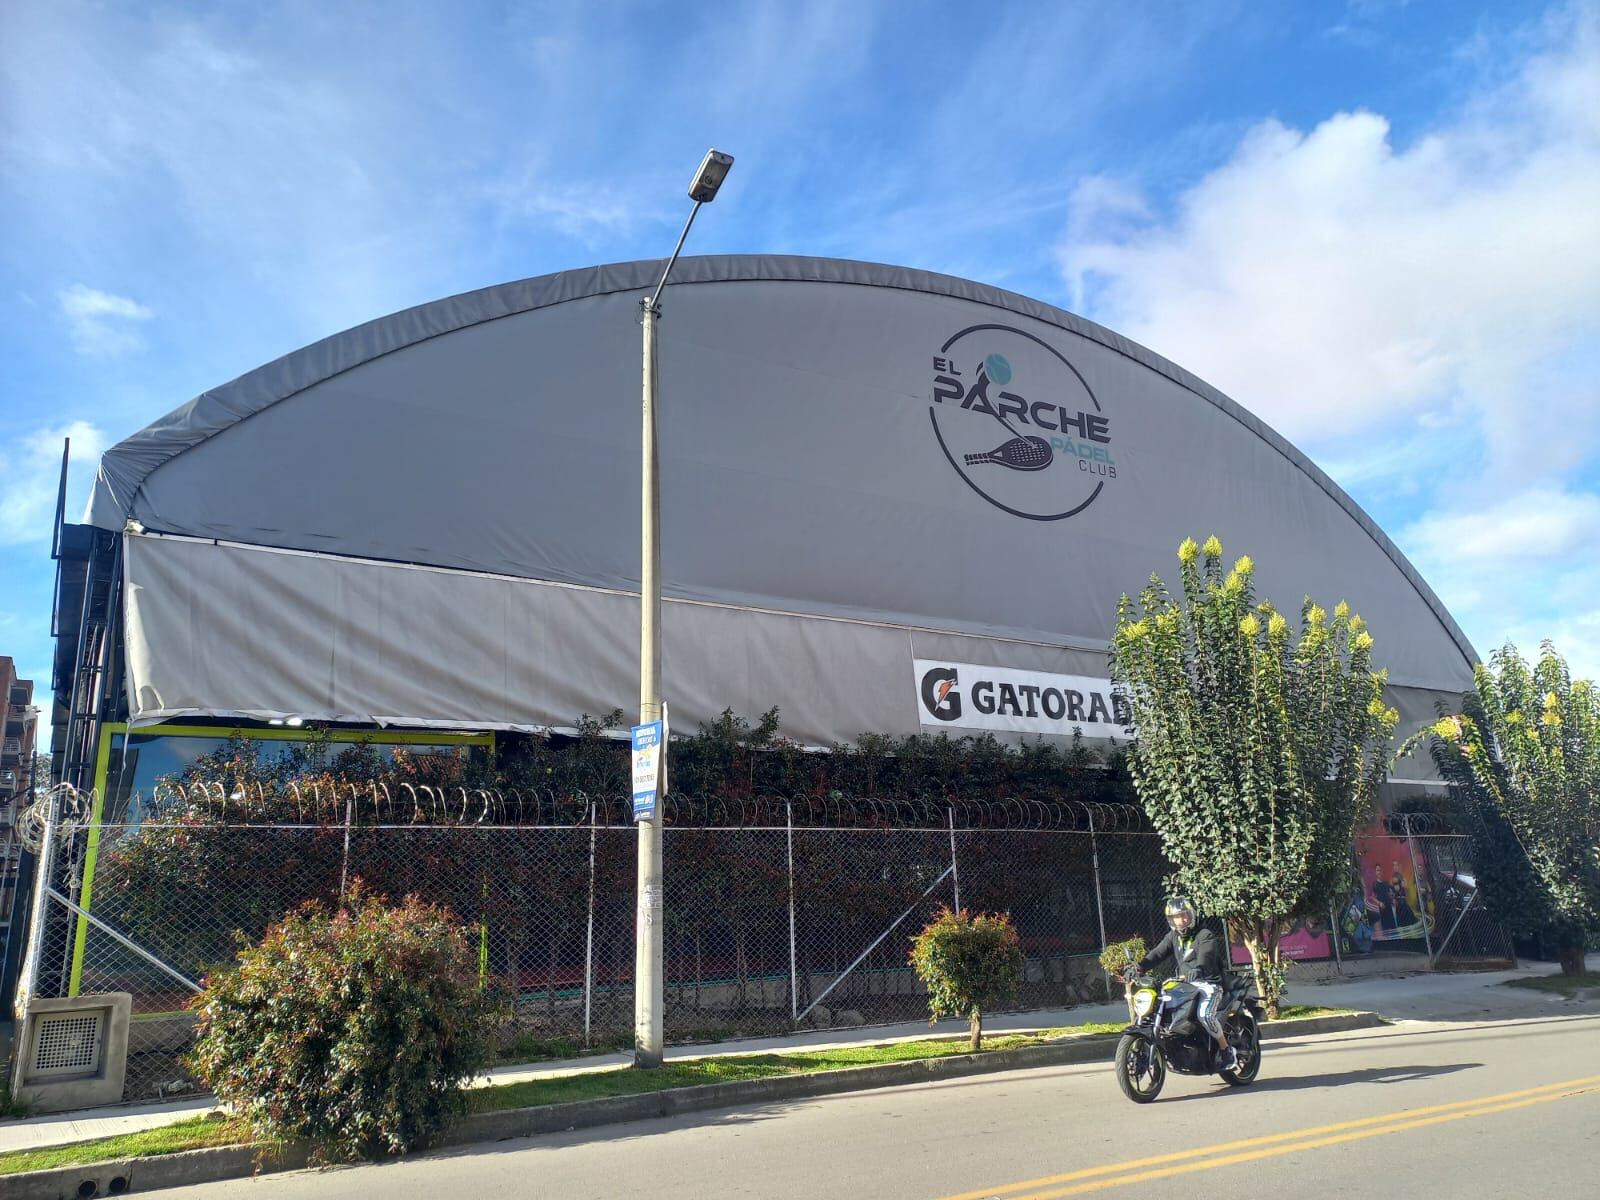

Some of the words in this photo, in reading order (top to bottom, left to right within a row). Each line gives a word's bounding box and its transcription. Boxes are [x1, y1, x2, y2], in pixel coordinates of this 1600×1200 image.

[933, 356, 962, 376] EL
[934, 374, 1112, 444] PARCHE
[1078, 459, 1117, 479] CLUB
[921, 667, 962, 722] G
[971, 680, 1133, 726] GATORAD
